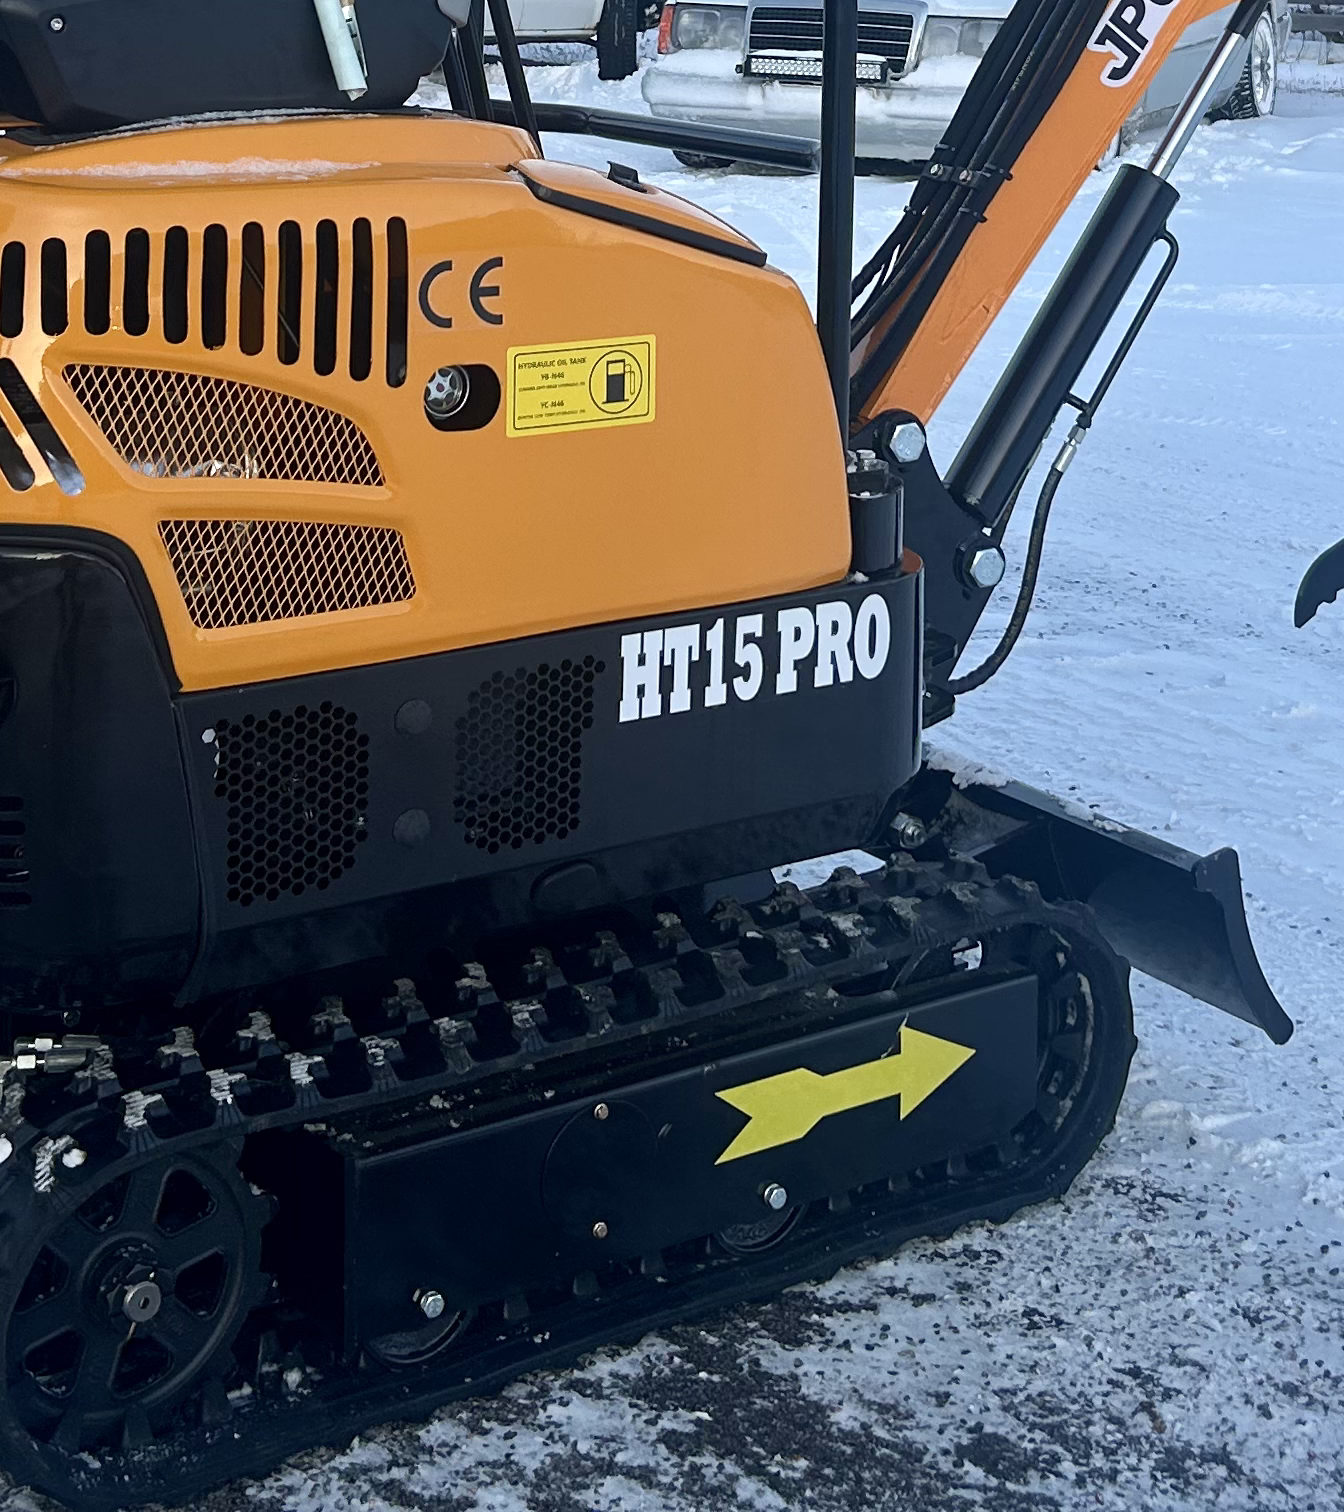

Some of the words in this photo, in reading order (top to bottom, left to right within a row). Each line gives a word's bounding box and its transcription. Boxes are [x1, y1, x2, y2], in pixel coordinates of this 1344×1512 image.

[418, 256, 503, 328] CE
[618, 613, 764, 723] HT15
[775, 593, 891, 695] PRO
